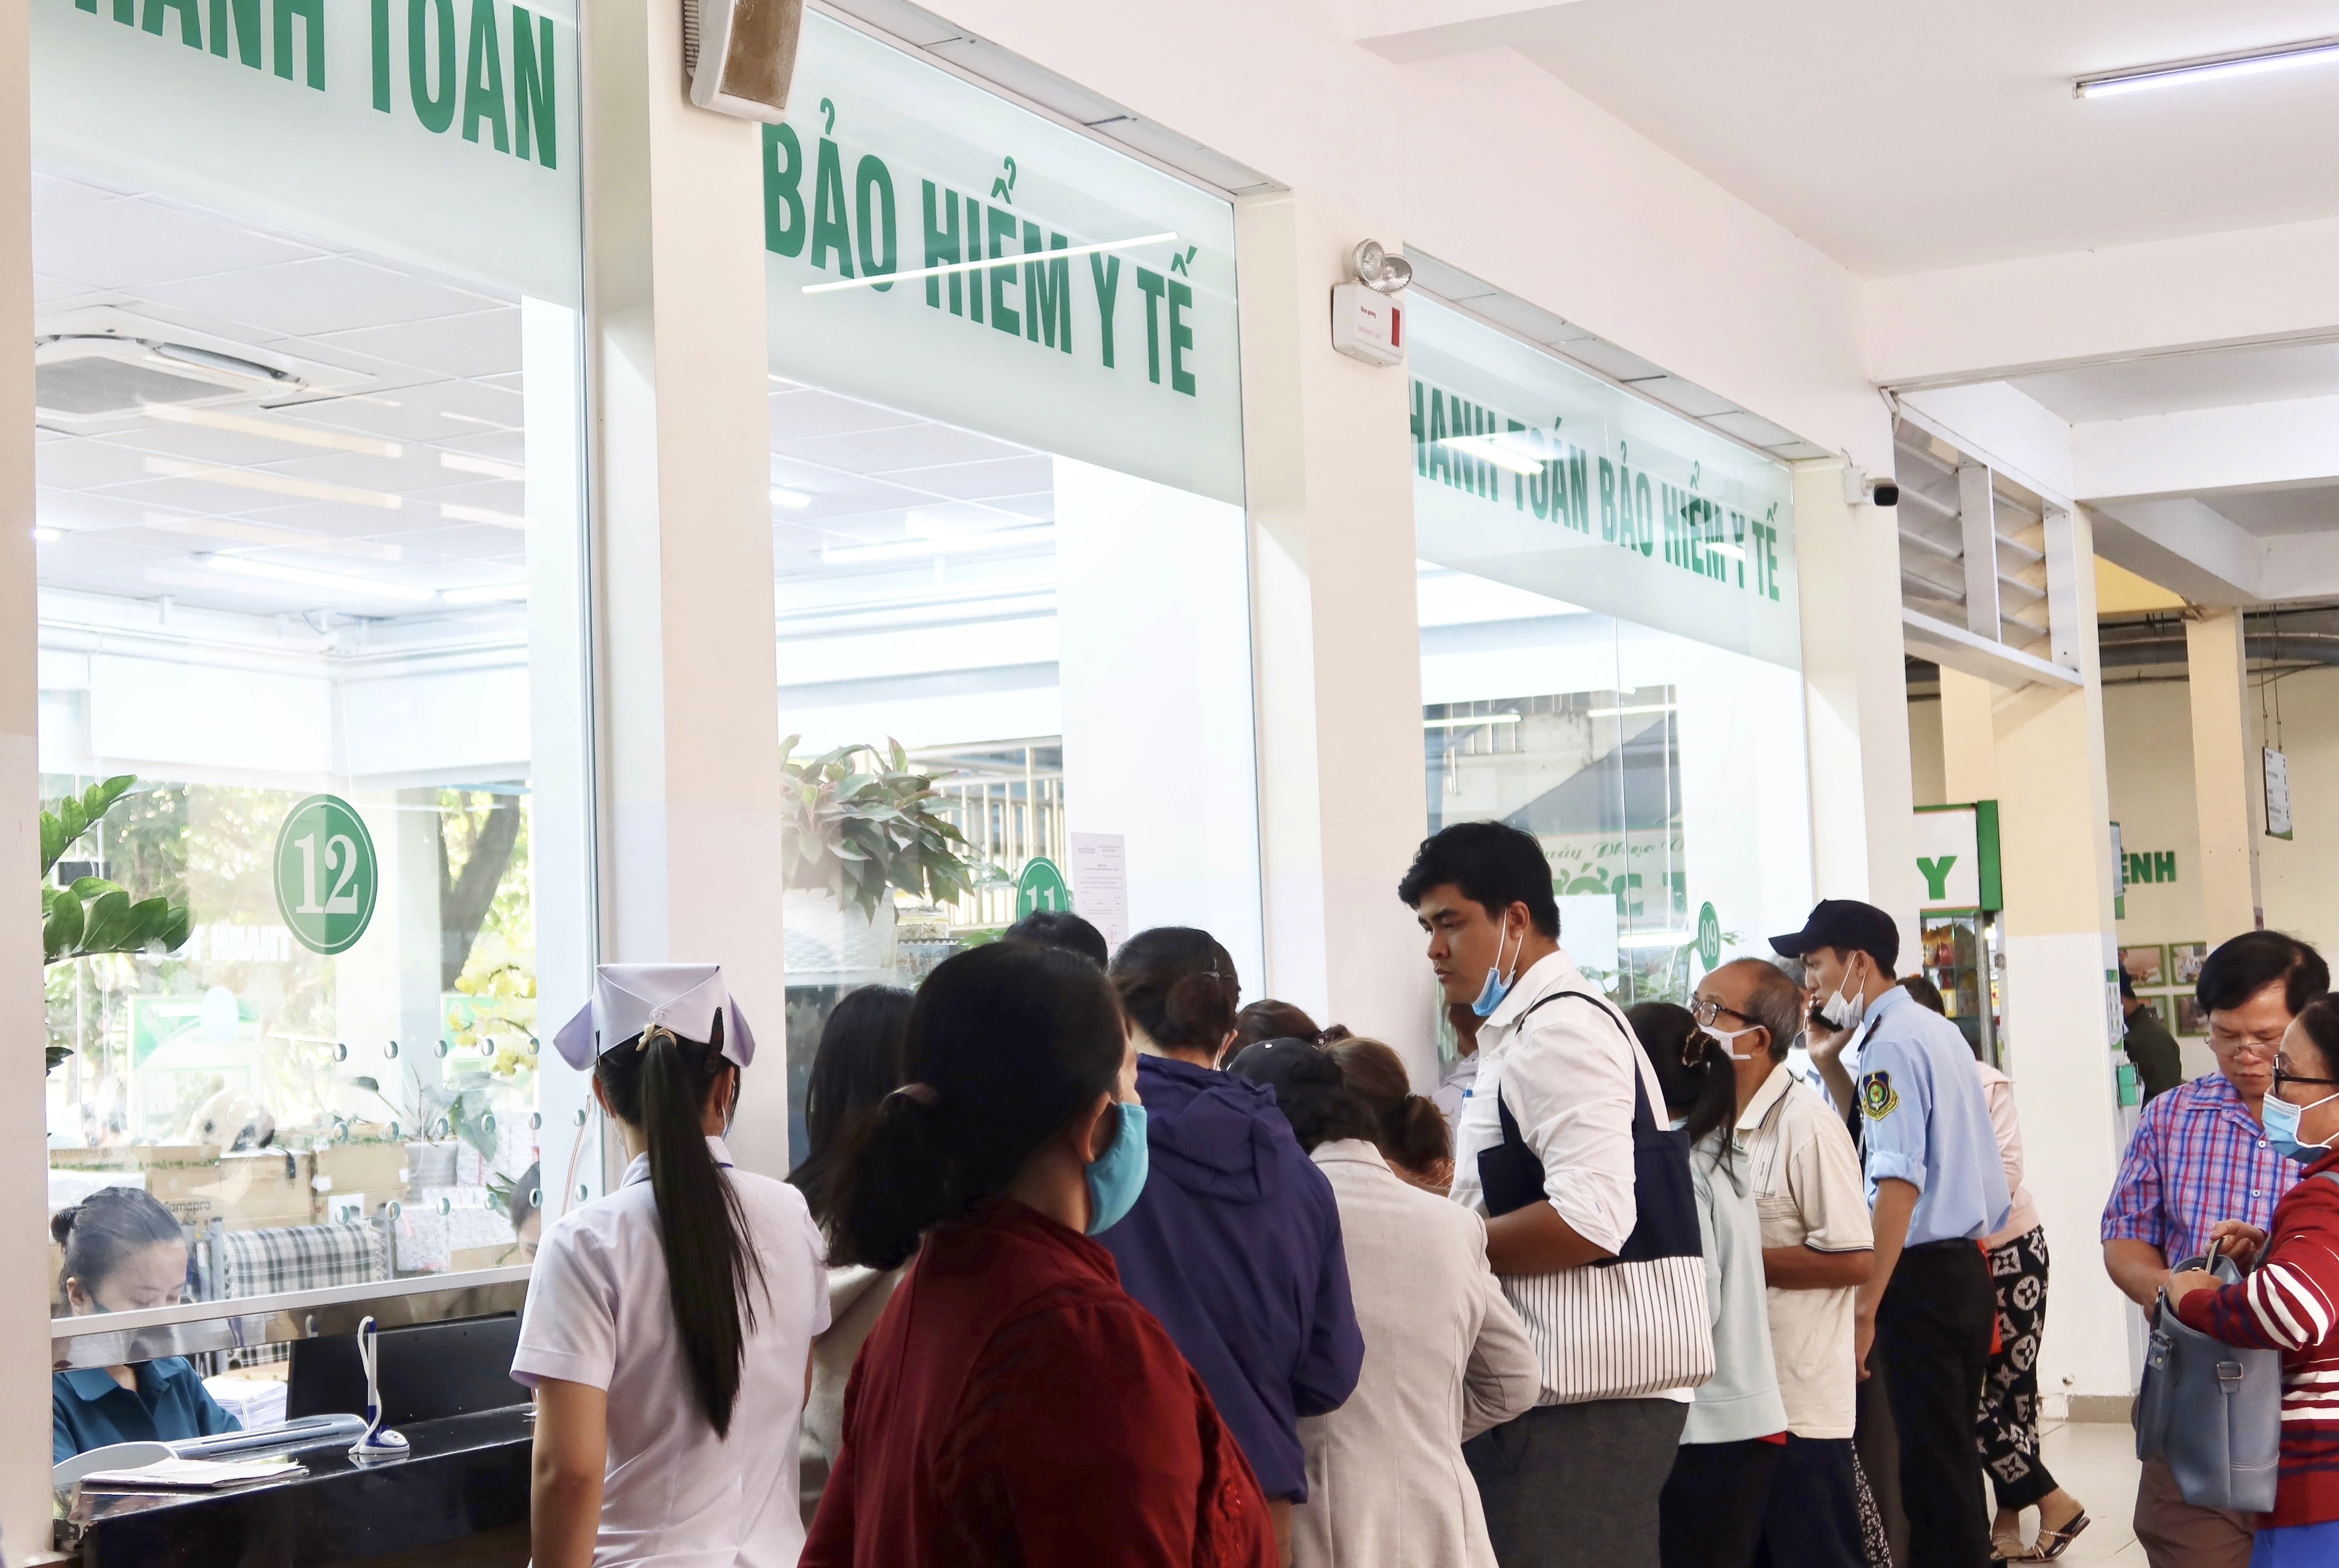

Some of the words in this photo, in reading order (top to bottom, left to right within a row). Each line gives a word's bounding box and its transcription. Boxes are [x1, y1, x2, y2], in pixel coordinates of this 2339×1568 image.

[762, 98, 897, 292] BẢO
[922, 156, 1072, 354] HIỂM
[1089, 251, 1120, 369] Y
[1137, 245, 1196, 397] TẾ
[1411, 380, 1499, 503] HANH
[1508, 416, 1590, 535] TOÁN
[1599, 440, 1654, 558] BẢO
[1662, 460, 1726, 583] HIỂM
[1731, 511, 1746, 589] Y
[1752, 502, 1780, 601] TẾ
[294, 832, 358, 914] 12
[1917, 856, 1957, 900] Y
[1702, 919, 1718, 957] 09
